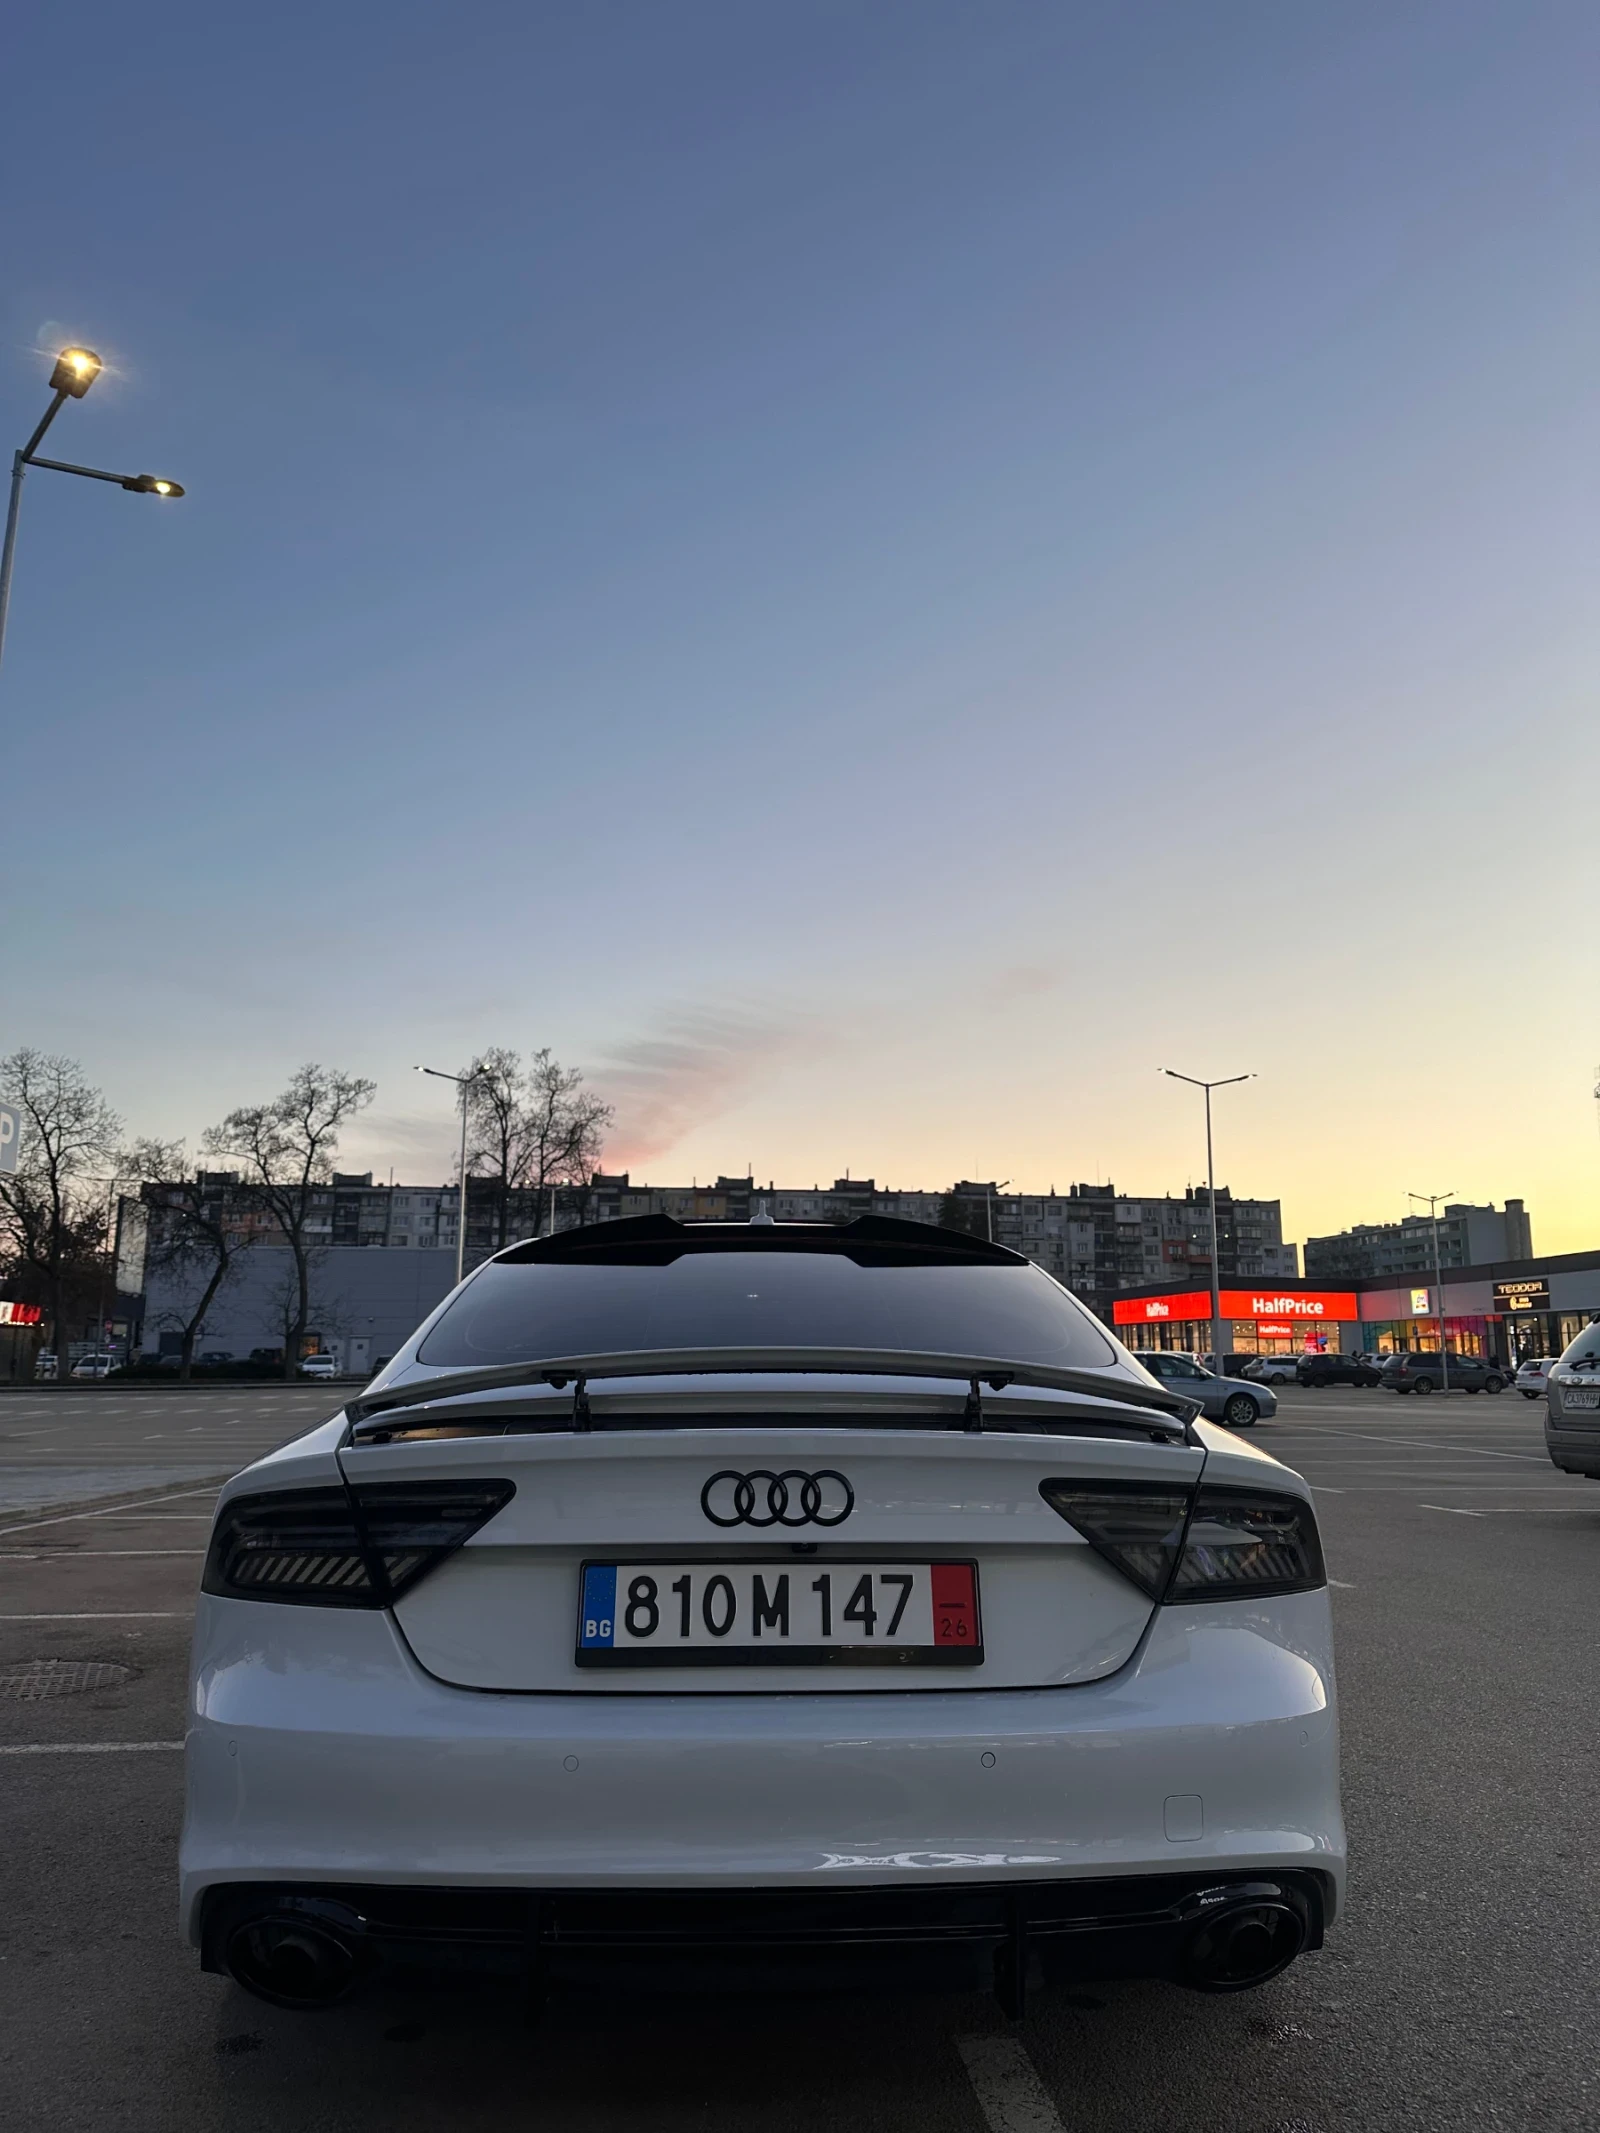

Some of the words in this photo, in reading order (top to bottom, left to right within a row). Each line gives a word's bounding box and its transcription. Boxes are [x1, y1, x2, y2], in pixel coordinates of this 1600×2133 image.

[1146, 1302, 1170, 1317] HalfPrice
[1252, 1298, 1324, 1315] HalfPrice
[1259, 1325, 1291, 1334] HalfPrice
[586, 1619, 612, 1638] BG
[940, 1617, 968, 1638] 26
